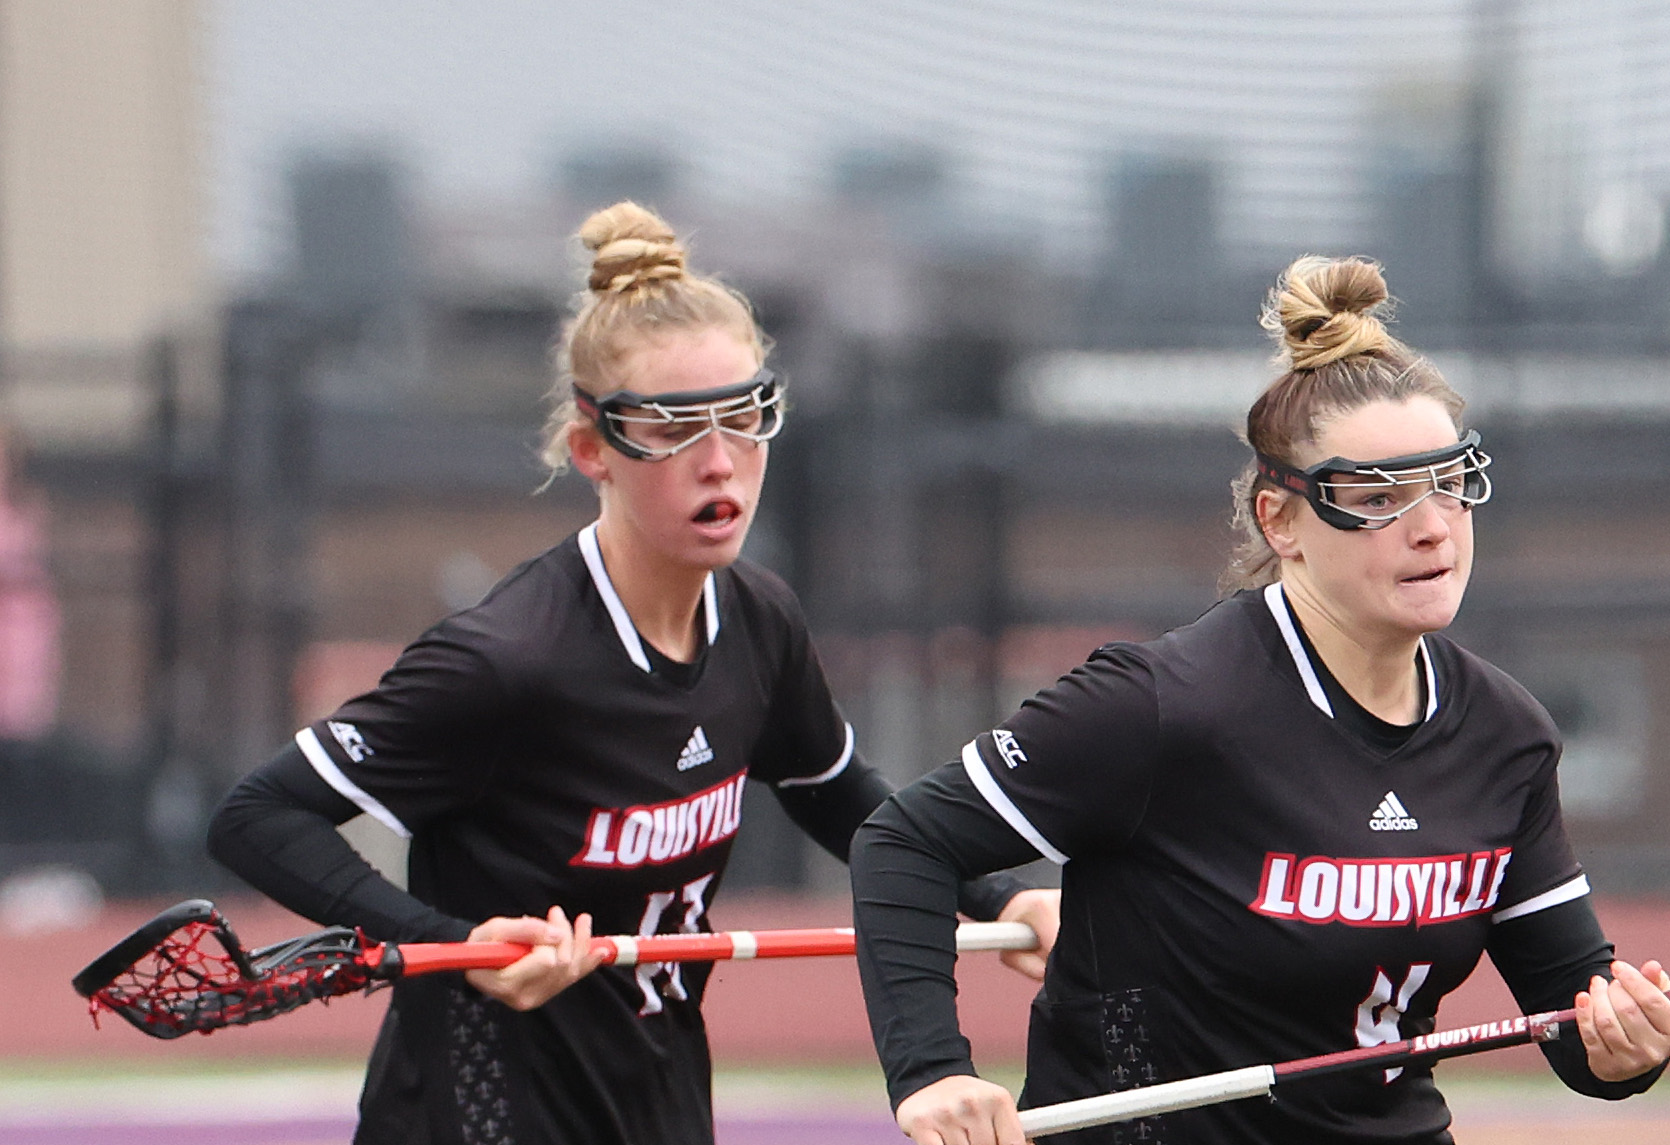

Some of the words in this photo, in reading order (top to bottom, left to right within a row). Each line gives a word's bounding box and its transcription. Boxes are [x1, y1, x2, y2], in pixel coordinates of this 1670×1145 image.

[992, 729, 1028, 769] ACC
[1368, 817, 1418, 831] adidas
[1413, 1016, 1529, 1052] LOUISVILLE
